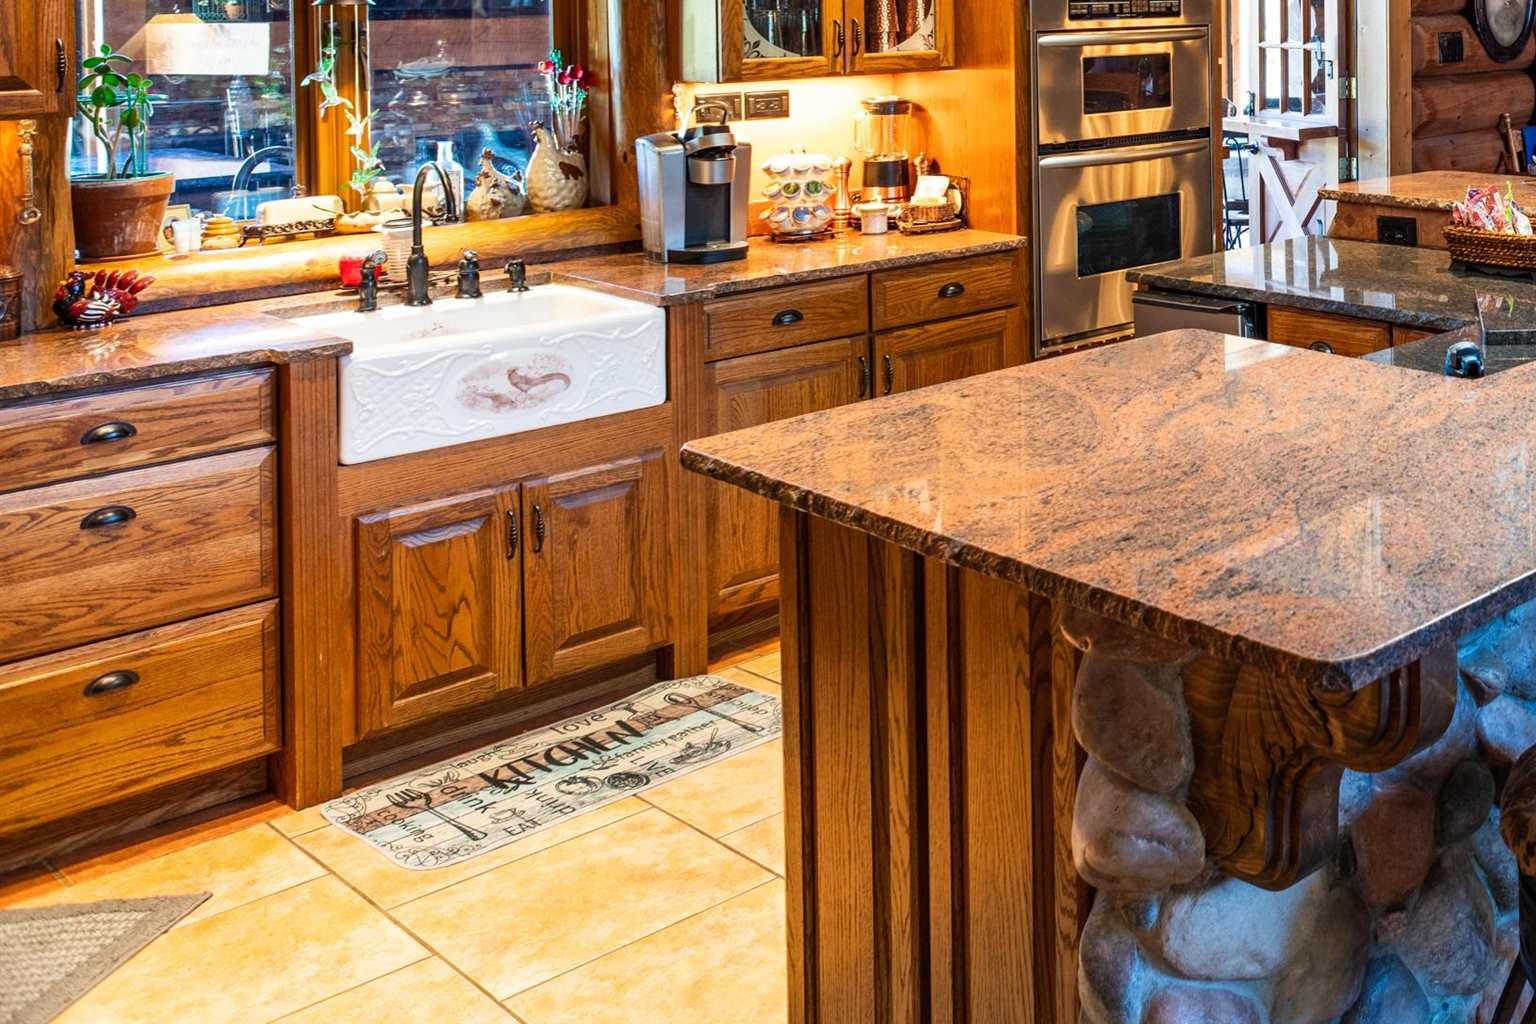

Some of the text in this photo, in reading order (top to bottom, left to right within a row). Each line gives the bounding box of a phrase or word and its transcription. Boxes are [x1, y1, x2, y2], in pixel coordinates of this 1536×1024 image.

[550, 711, 606, 735] love
[477, 719, 645, 790] KITCHEN
[439, 784, 497, 815] drink
[376, 808, 434, 843] cooking
[502, 817, 543, 837] EAT
